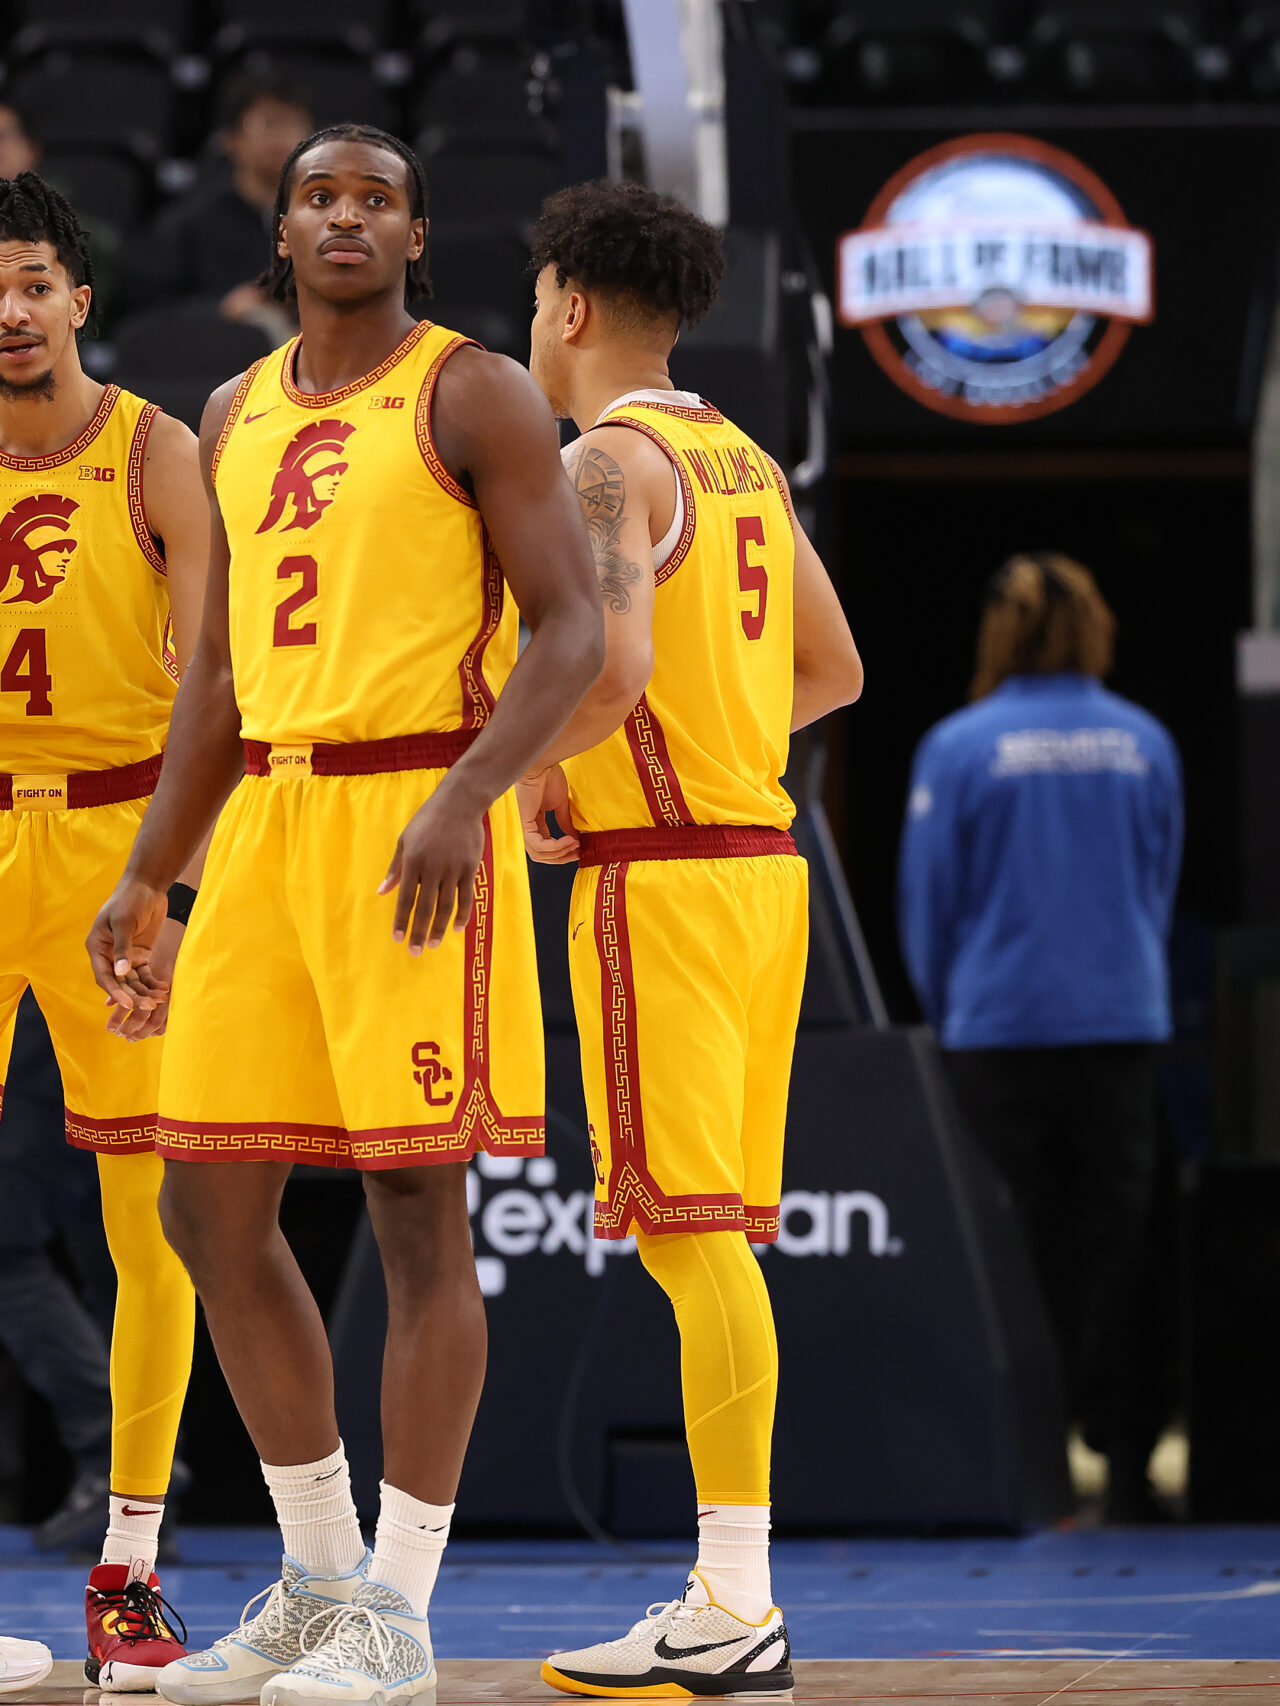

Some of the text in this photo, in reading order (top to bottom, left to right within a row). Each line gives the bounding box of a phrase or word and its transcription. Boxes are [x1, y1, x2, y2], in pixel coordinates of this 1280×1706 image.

[864, 243, 958, 297] HALL
[1023, 240, 1128, 297] FAME
[682, 446, 764, 495] WILLIAMS
[273, 555, 318, 647] 2
[736, 516, 768, 640] 5
[1, 628, 53, 716] 4
[271, 756, 306, 765] FIGHT ON
[17, 789, 62, 798] FIGHT ON
[412, 1041, 453, 1106] SC
